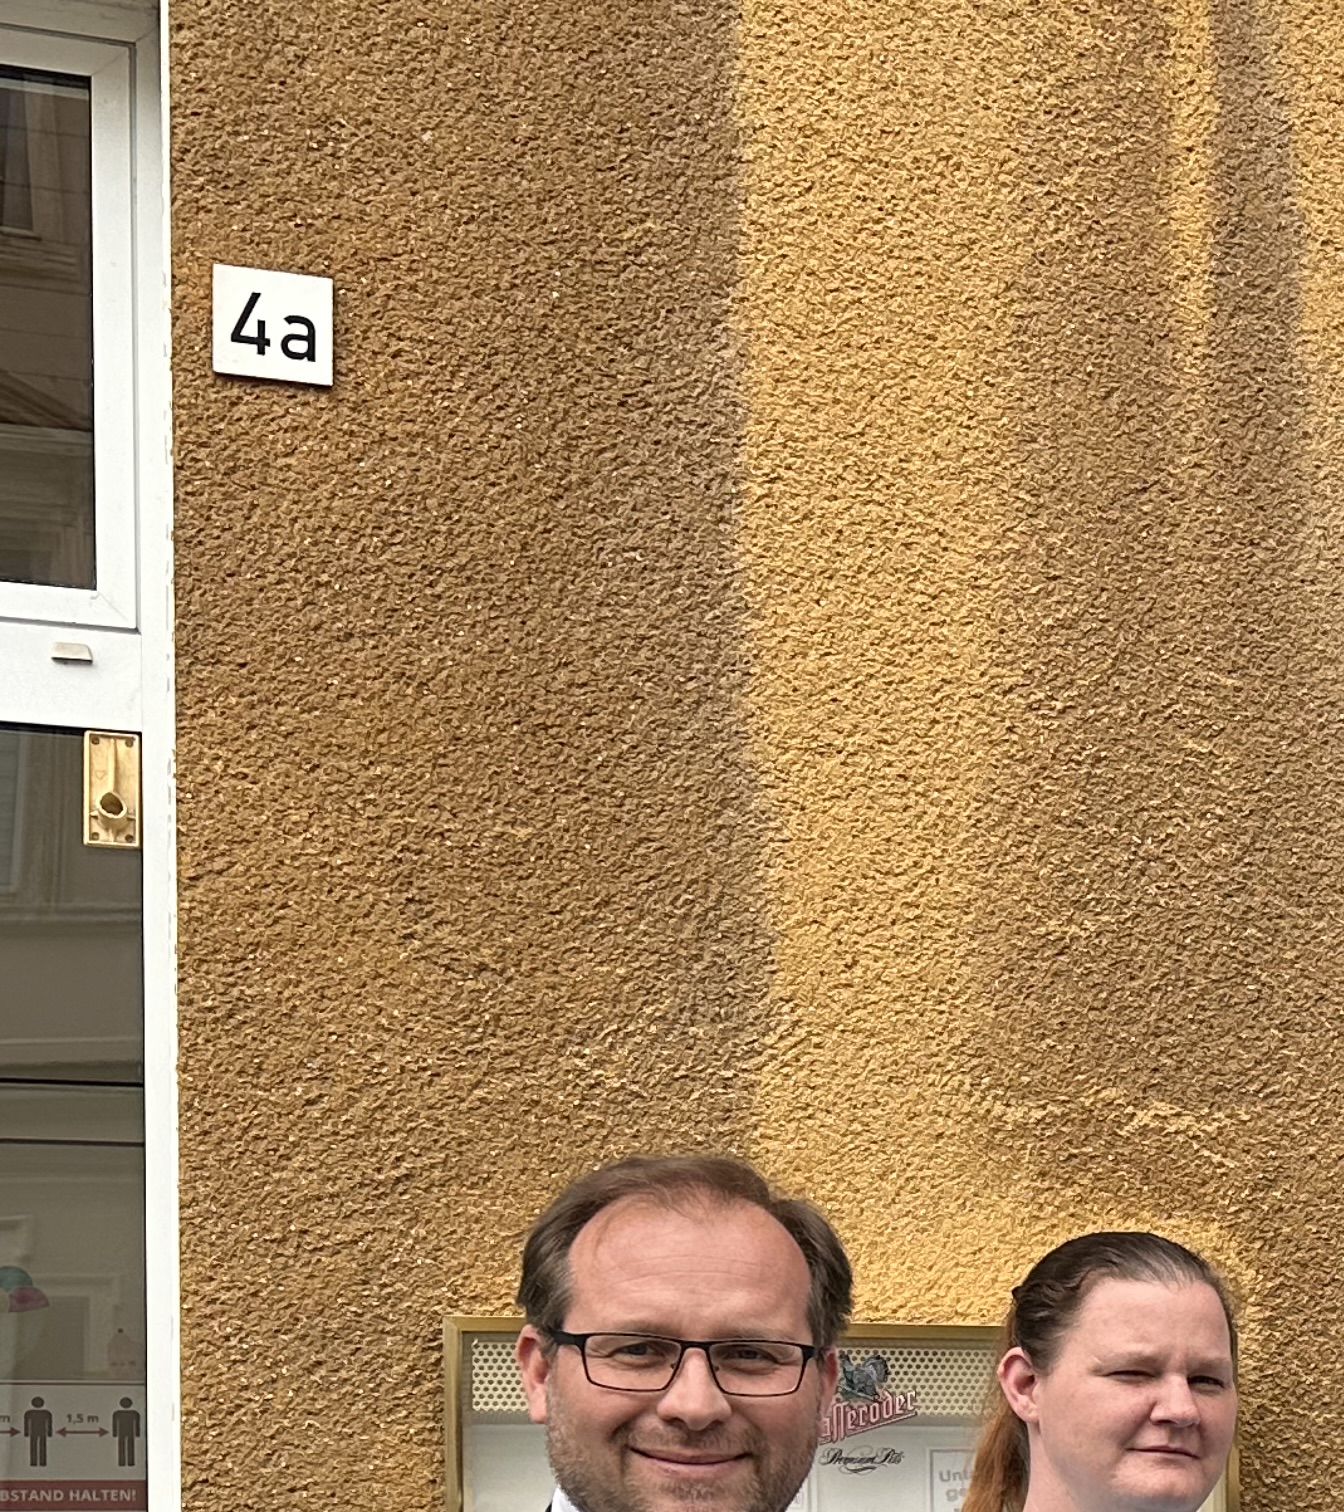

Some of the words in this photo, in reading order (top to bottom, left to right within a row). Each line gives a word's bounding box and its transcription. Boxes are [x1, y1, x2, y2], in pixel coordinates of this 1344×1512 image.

[230, 292, 317, 362] 4a
[87, 1415, 99, 1423] m
[0, 1489, 64, 1501] BSTAND
[69, 1489, 136, 1501] HALTEN!
